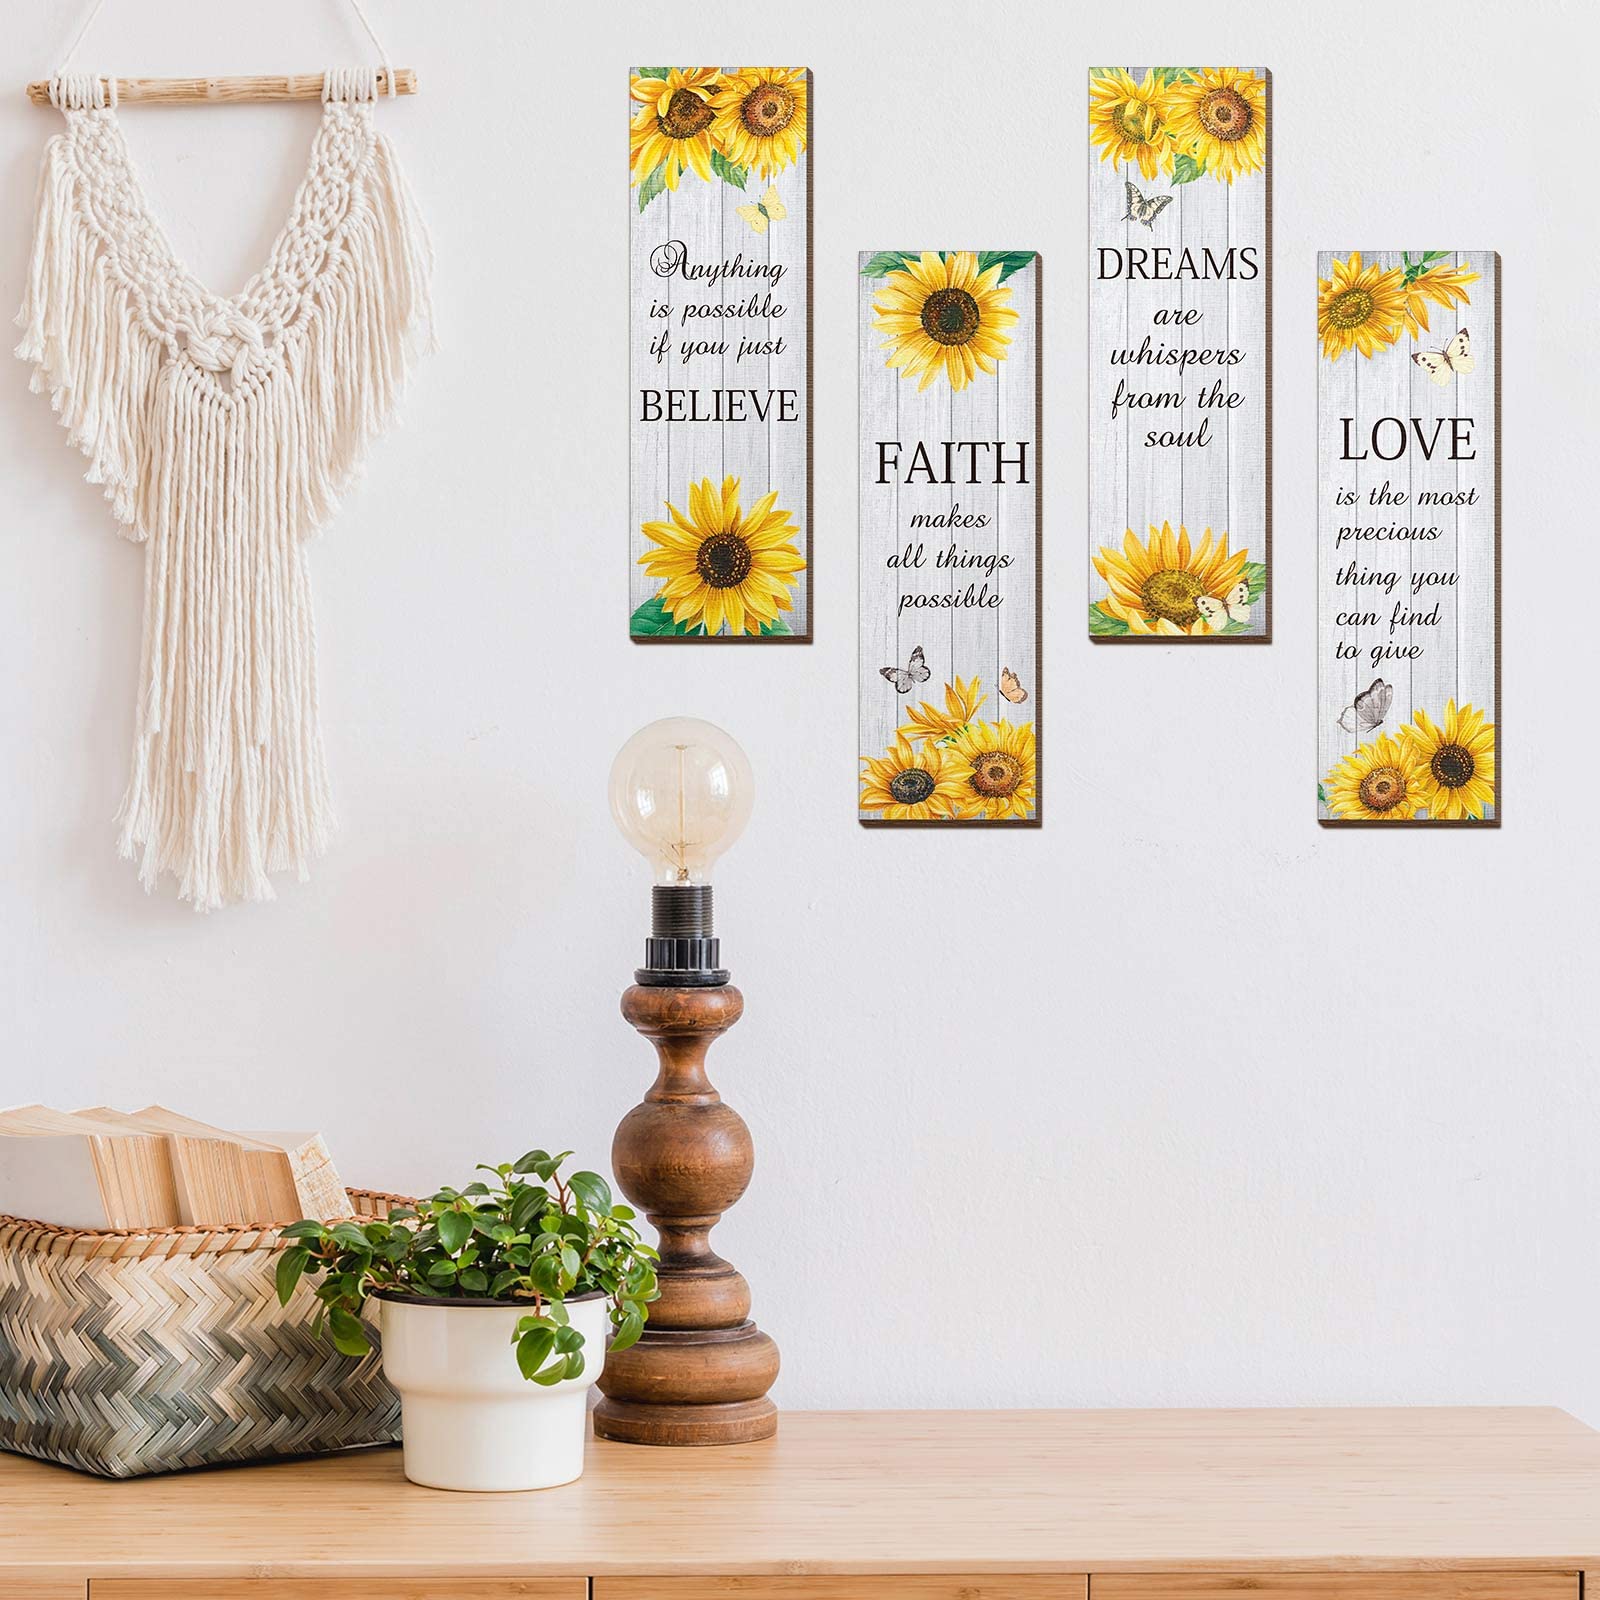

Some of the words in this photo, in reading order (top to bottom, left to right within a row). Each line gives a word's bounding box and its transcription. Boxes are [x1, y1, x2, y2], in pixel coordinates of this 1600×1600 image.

[649, 239, 788, 288] Anything
[1097, 247, 1259, 280] DREAMS
[649, 299, 674, 319] is
[681, 293, 788, 327] possible
[1153, 309, 1204, 326] are
[649, 329, 672, 364] if
[680, 341, 730, 365] you
[736, 336, 787, 364] just
[1110, 335, 1247, 376] whispers
[639, 389, 799, 422] BELIEVE
[1111, 378, 1187, 419] from
[1197, 378, 1246, 409] the
[1144, 417, 1213, 448] soul
[1339, 417, 1477, 461] LOVE
[875, 440, 1030, 484] FAITH
[1335, 487, 1360, 506] is
[1369, 480, 1410, 506] the
[1417, 487, 1479, 506] most
[910, 502, 992, 529] makes
[1335, 522, 1443, 550] precious
[886, 543, 927, 569] all
[936, 543, 1015, 576] things
[1335, 560, 1402, 594] thing
[1410, 572, 1460, 594] you
[897, 582, 1004, 618] possible
[1335, 612, 1381, 626] can
[1389, 600, 1442, 635] find
[1335, 641, 1362, 660] to
[1370, 641, 1424, 669] give
